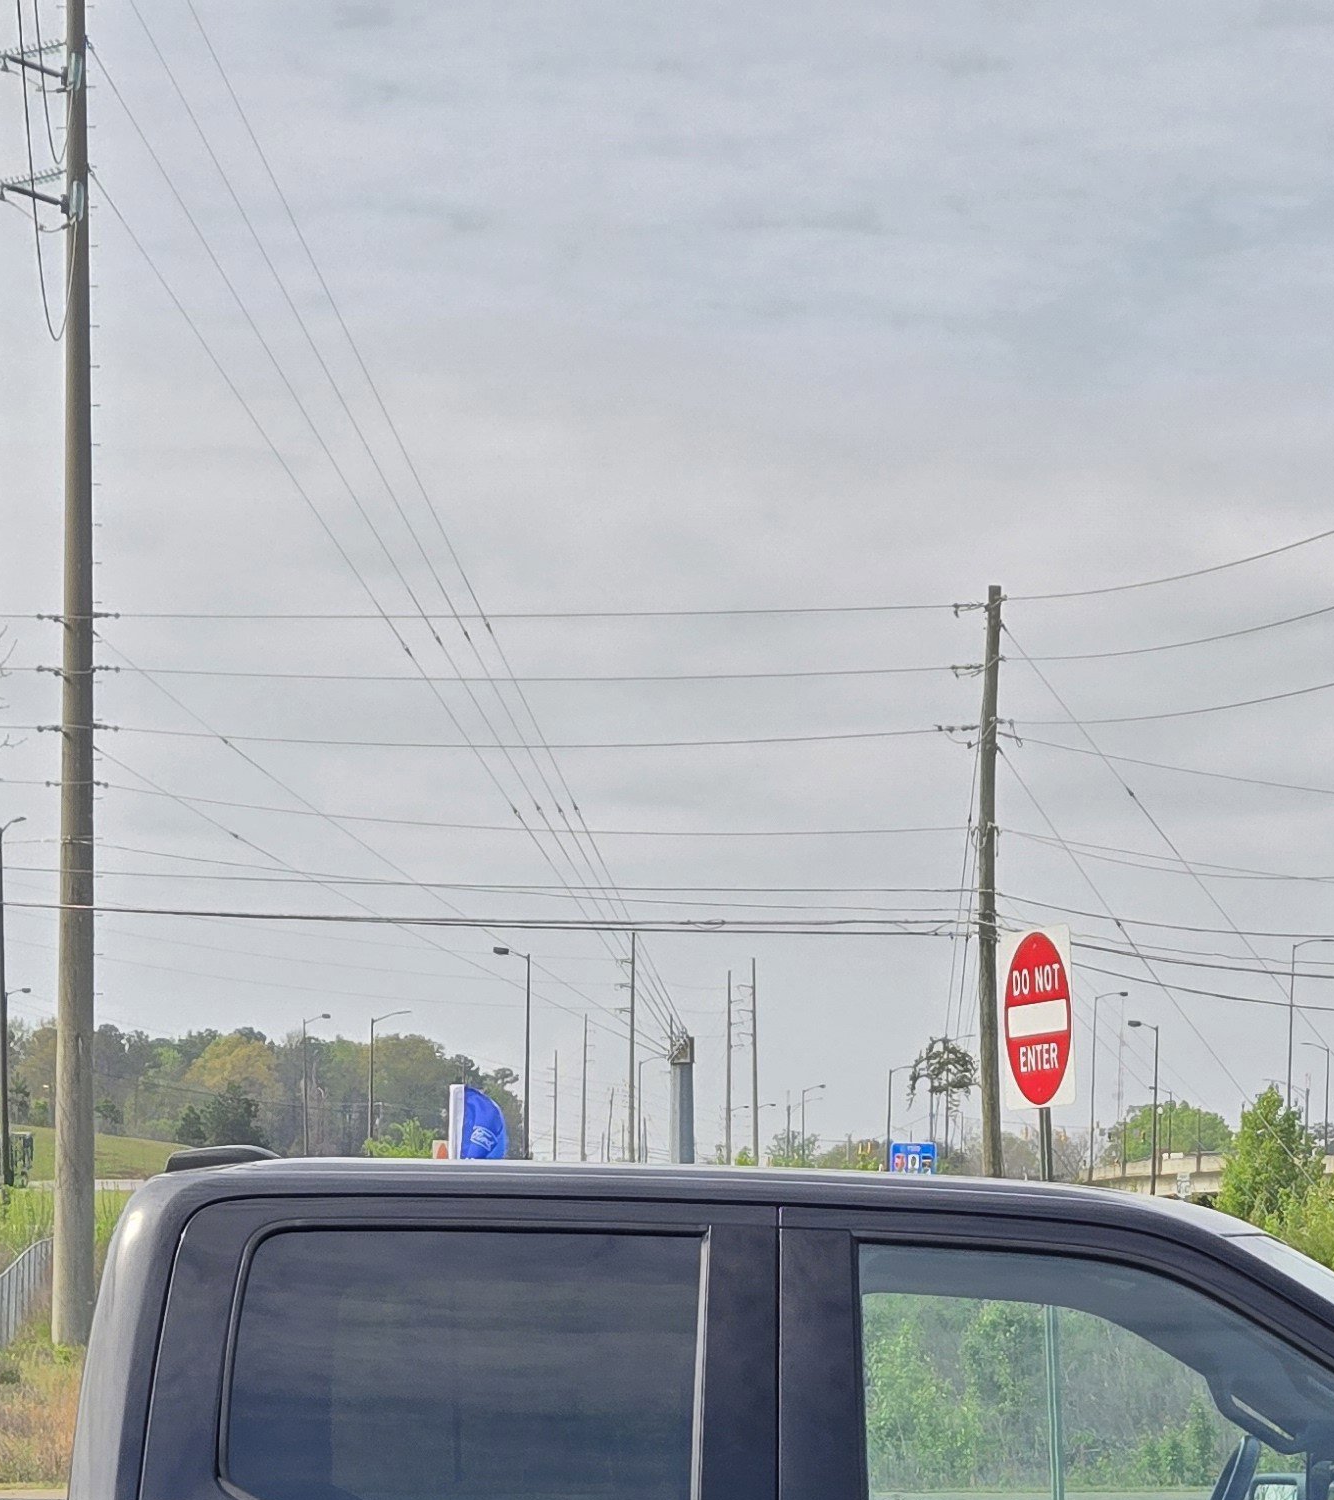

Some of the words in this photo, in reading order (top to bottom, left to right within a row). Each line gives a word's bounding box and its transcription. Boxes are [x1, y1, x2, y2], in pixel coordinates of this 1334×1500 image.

[1012, 968, 1030, 996] DO
[1034, 963, 1060, 993] NOT
[1019, 1042, 1059, 1073] ENTER
